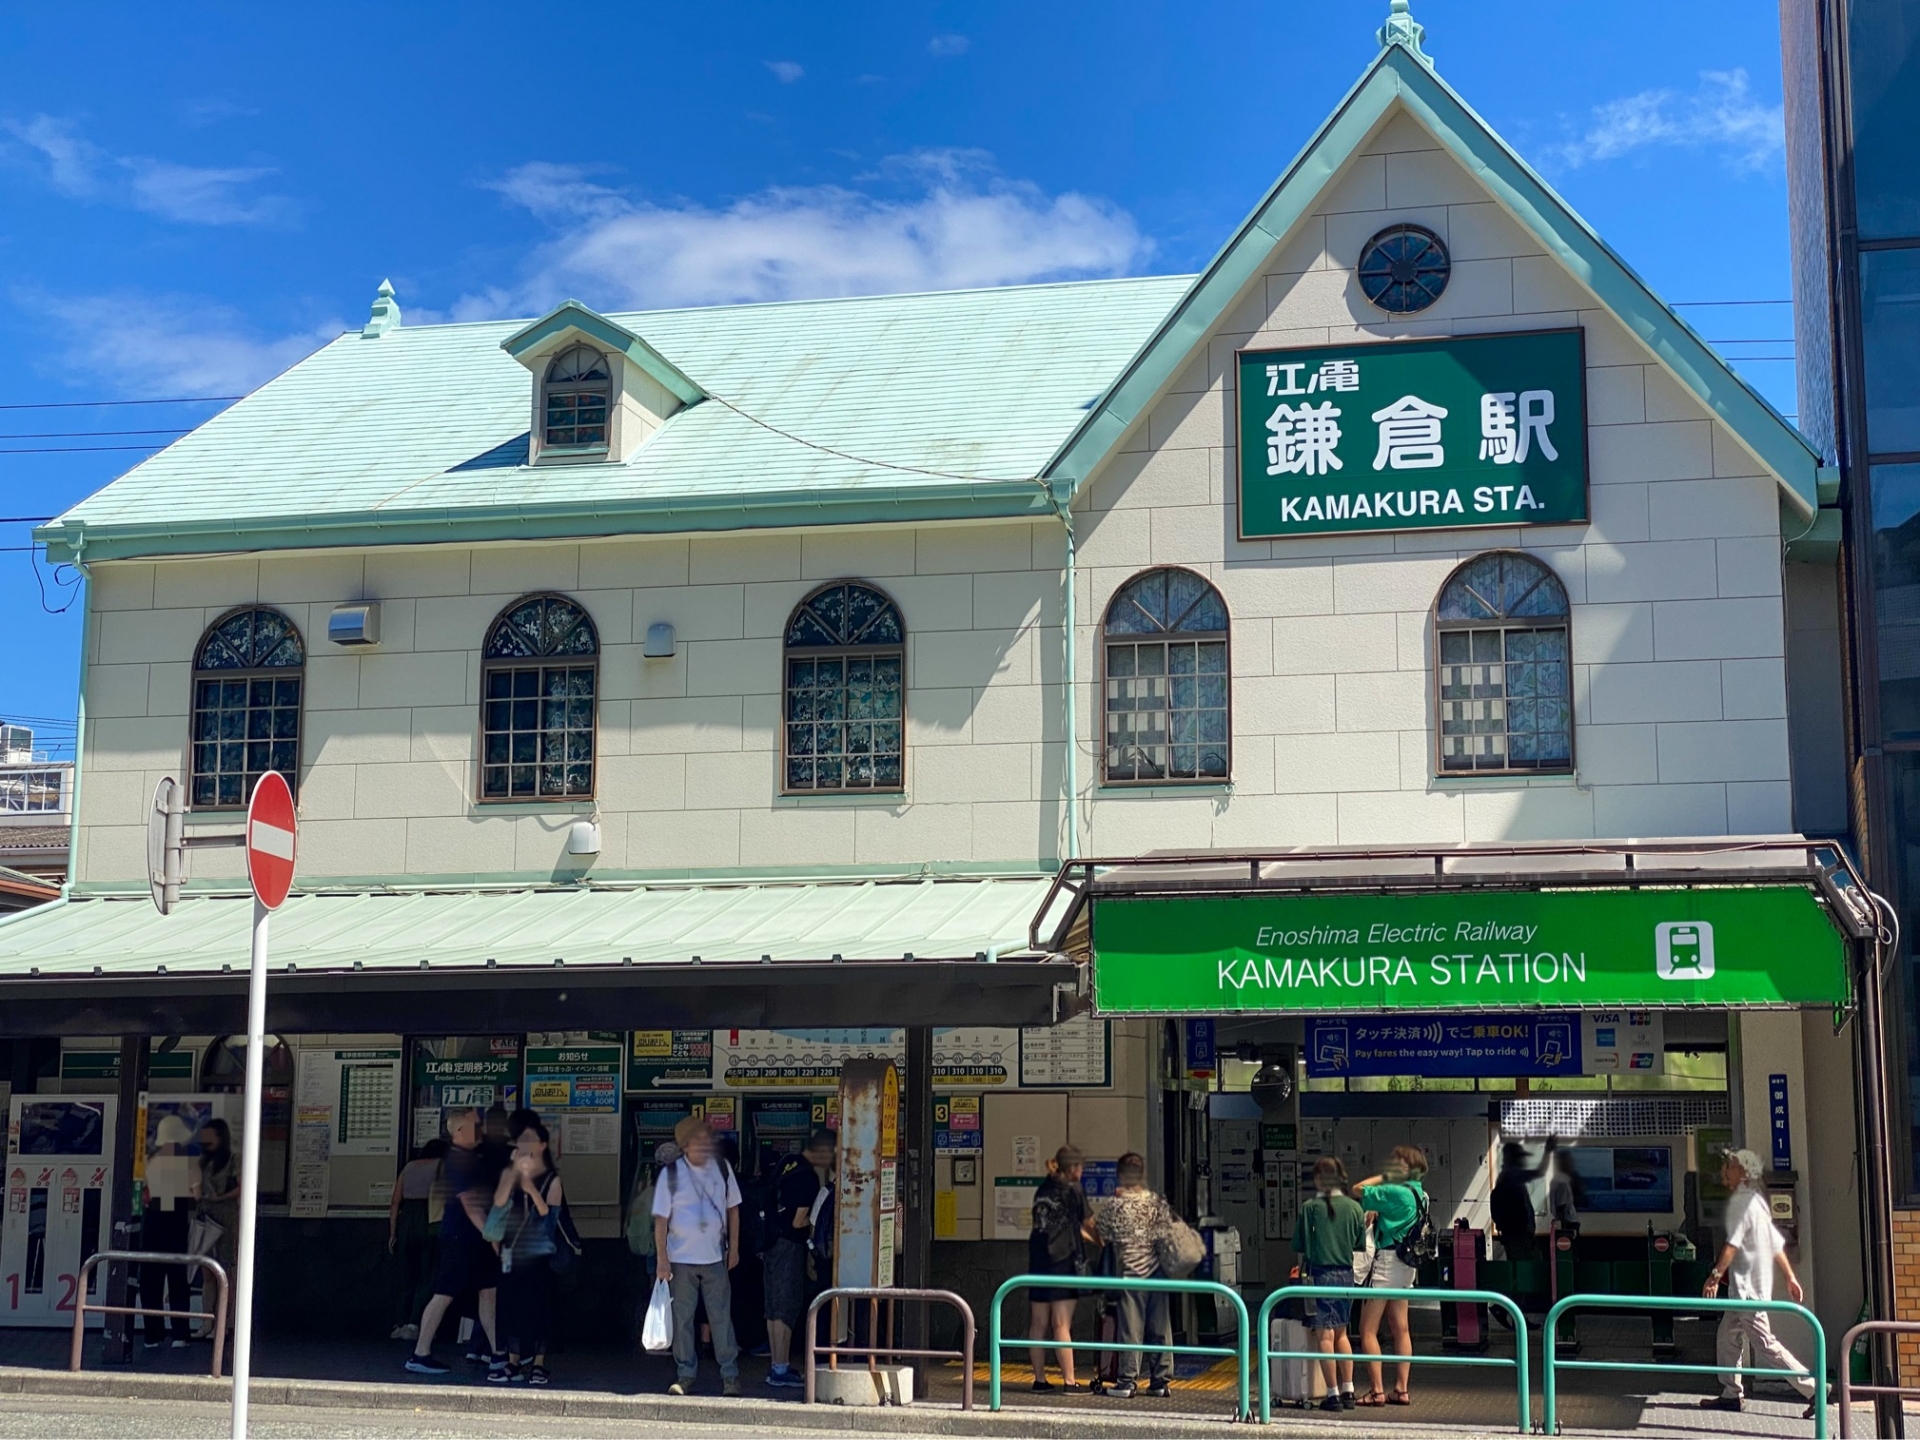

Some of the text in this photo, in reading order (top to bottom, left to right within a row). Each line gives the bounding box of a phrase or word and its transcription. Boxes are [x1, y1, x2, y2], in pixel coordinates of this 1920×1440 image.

[1265, 360, 1360, 396] 江ノ電
[1265, 389, 1559, 476] 鎌倉駅
[1281, 485, 1546, 522] KAMAKURA STA.
[1256, 920, 1539, 948] Enoshima Electric Railway
[1217, 952, 1587, 990] KAMAKURA STATION
[1593, 1014, 1620, 1023] VISA
[1355, 1027, 1421, 1041] タッチ決済
[557, 1052, 589, 1062] お知らせ
[1355, 1050, 1372, 1060] Pay
[1374, 1049, 1398, 1058] fares
[1400, 1049, 1415, 1058] the
[1417, 1050, 1438, 1060] easy
[1441, 1048, 1464, 1059] way!
[1466, 1048, 1483, 1058] Tap
[1497, 1047, 1517, 1056] ride
[746, 1069, 759, 1077] 200
[764, 1069, 778, 1077] 200
[783, 1069, 796, 1077] 200
[801, 1069, 815, 1077] 220
[820, 1069, 833, 1077] 220
[933, 1068, 946, 1076] 310
[952, 1068, 965, 1076] 310
[989, 1067, 1002, 1075] 310
[444, 1086, 493, 1105] 江ノ電
[694, 1106, 701, 1117] 1
[814, 1106, 823, 1120] 2
[937, 1106, 946, 1120] 3
[6, 1274, 19, 1309] 1
[56, 1274, 78, 1312] 2
